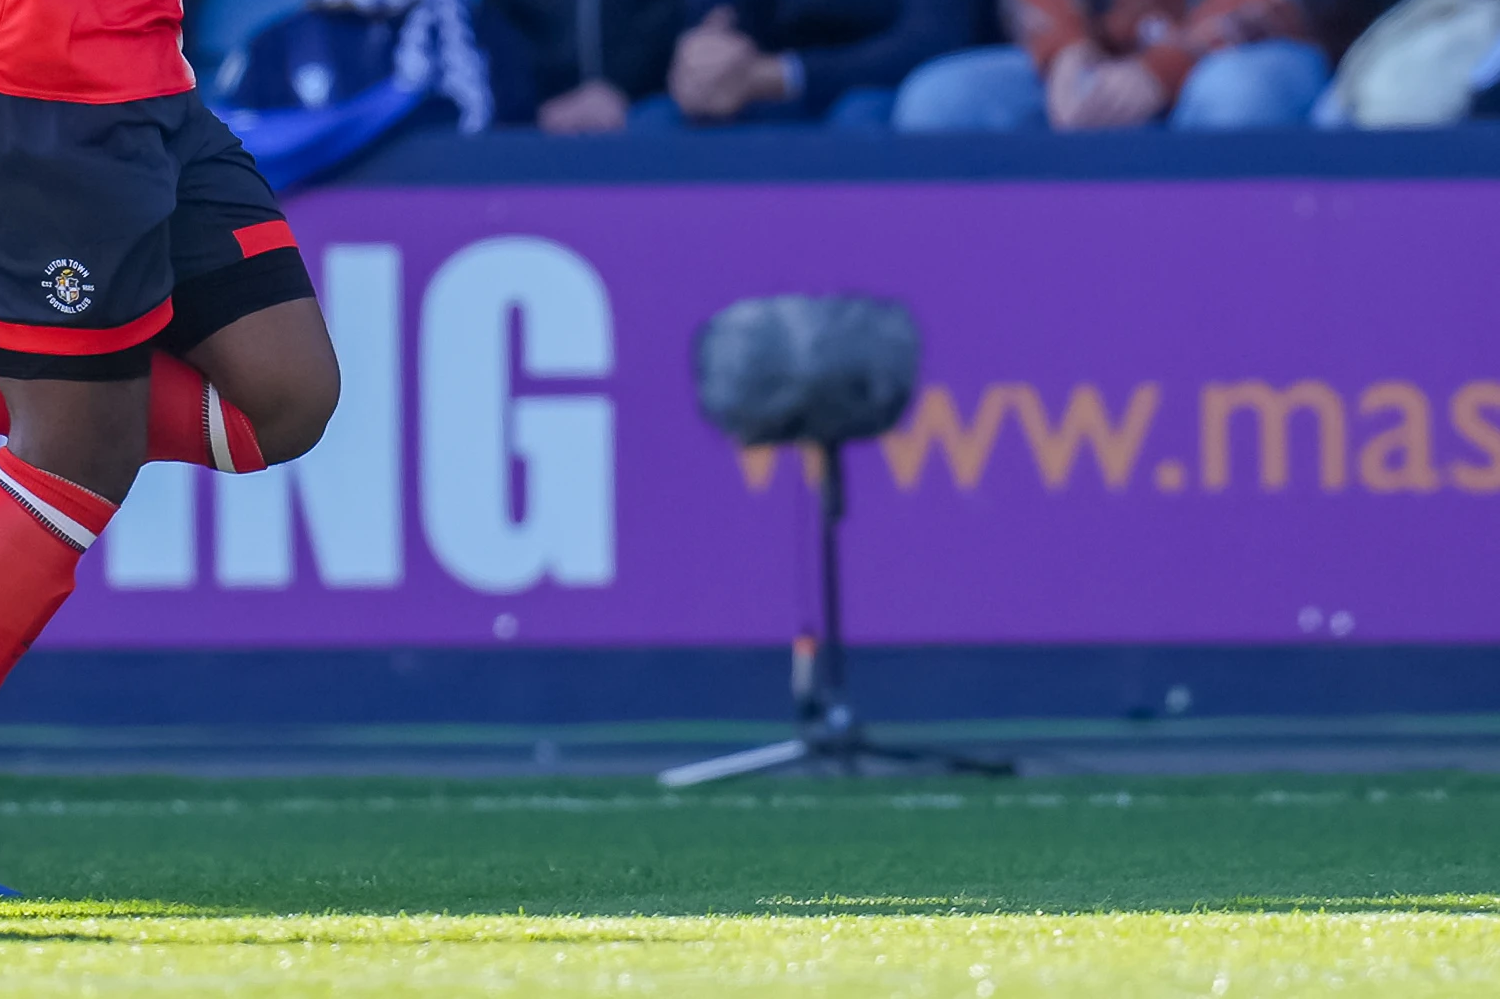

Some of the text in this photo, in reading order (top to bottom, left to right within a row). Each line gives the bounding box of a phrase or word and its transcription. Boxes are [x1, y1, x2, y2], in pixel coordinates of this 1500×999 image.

[44, 258, 90, 278] LUTON TOWN
[46, 293, 92, 314] FOOTBALL CLUB
